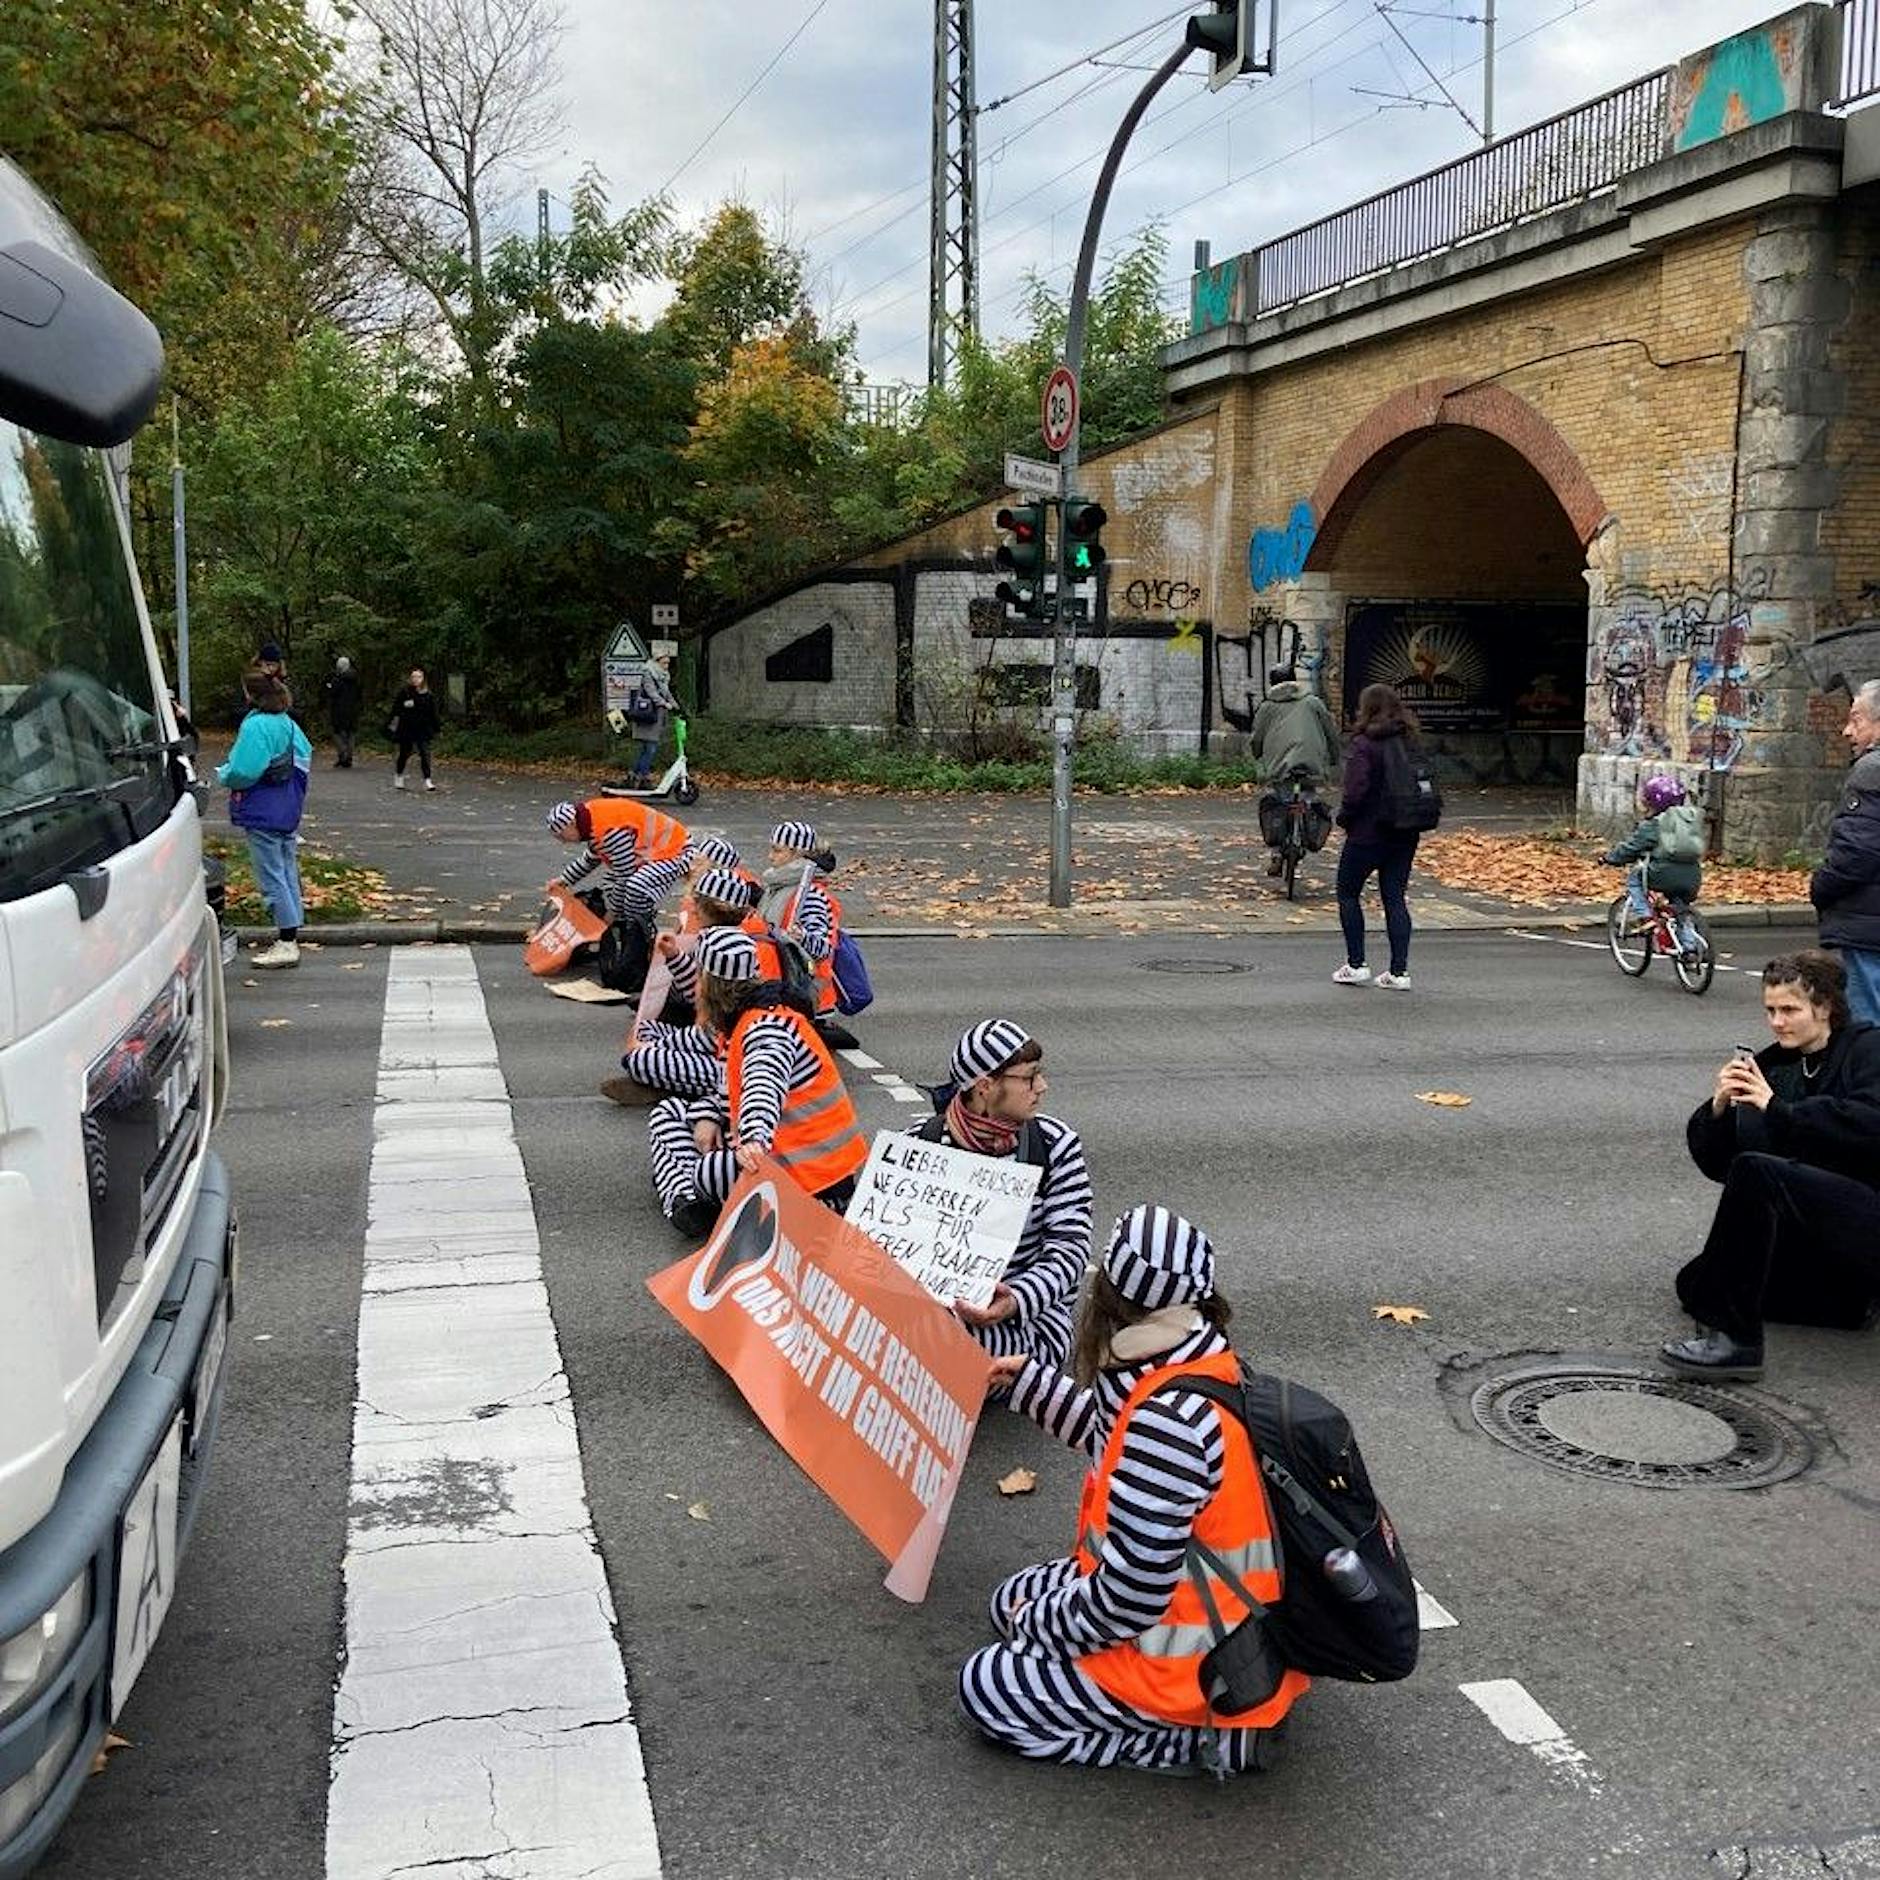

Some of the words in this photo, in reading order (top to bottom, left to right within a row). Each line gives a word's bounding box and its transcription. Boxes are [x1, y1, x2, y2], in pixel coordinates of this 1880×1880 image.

[881, 1143, 949, 1178] LIEBER
[873, 1172, 990, 1217] WEGSPERREN
[860, 1197, 913, 1226] ALS
[935, 1209, 974, 1249] FÜR
[844, 1305, 888, 1371] DIE
[732, 1274, 793, 1328] DAS
[819, 1354, 864, 1420] IM
[853, 1390, 920, 1482] GRIFF
